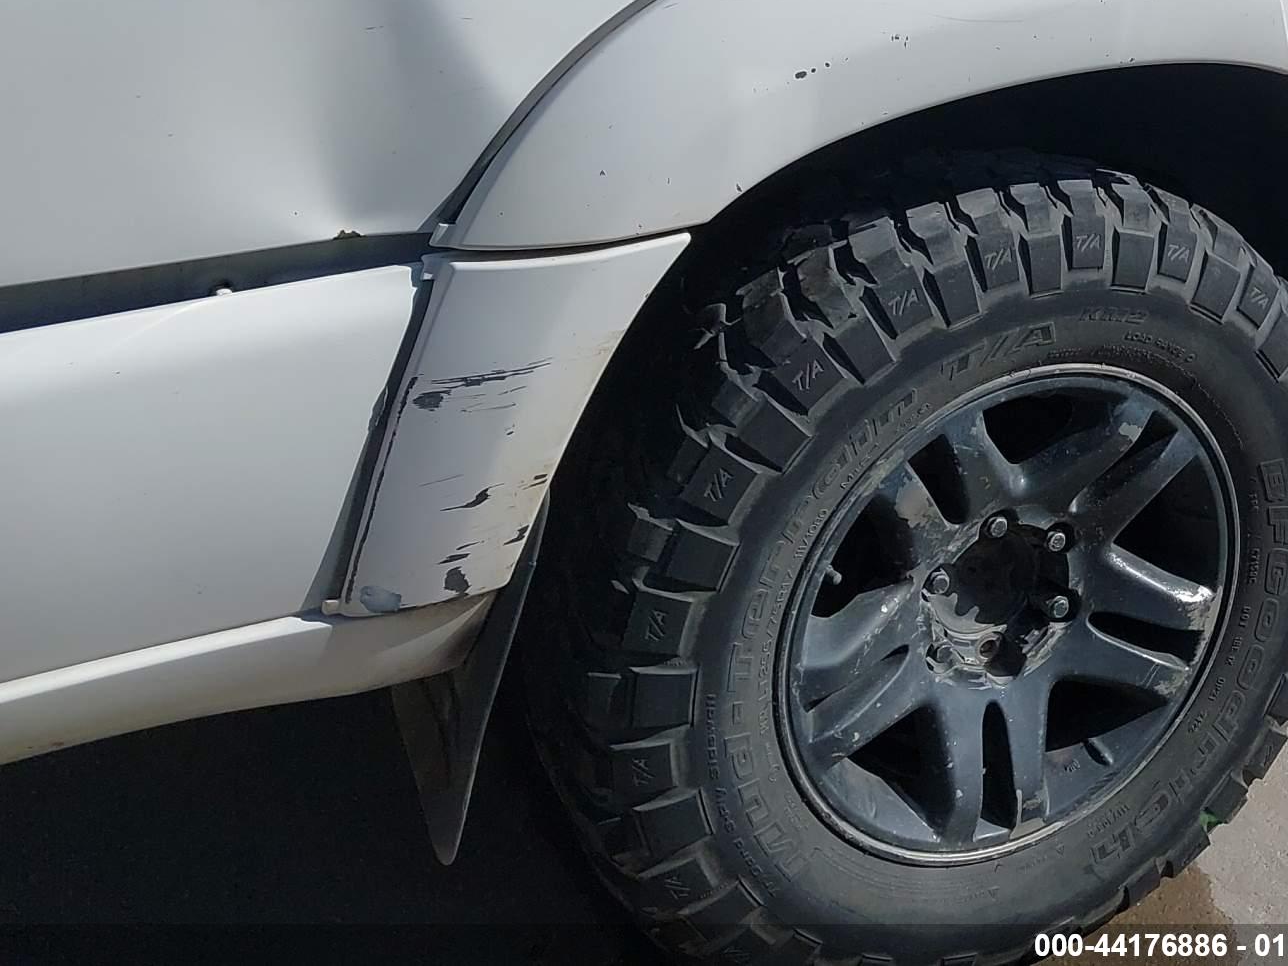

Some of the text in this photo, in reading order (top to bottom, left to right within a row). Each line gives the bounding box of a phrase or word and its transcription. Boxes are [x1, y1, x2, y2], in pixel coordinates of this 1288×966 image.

[1075, 235, 1101, 252] T/A
[889, 289, 920, 316] T/A
[792, 359, 824, 391] T/A
[704, 467, 736, 502] T/A
